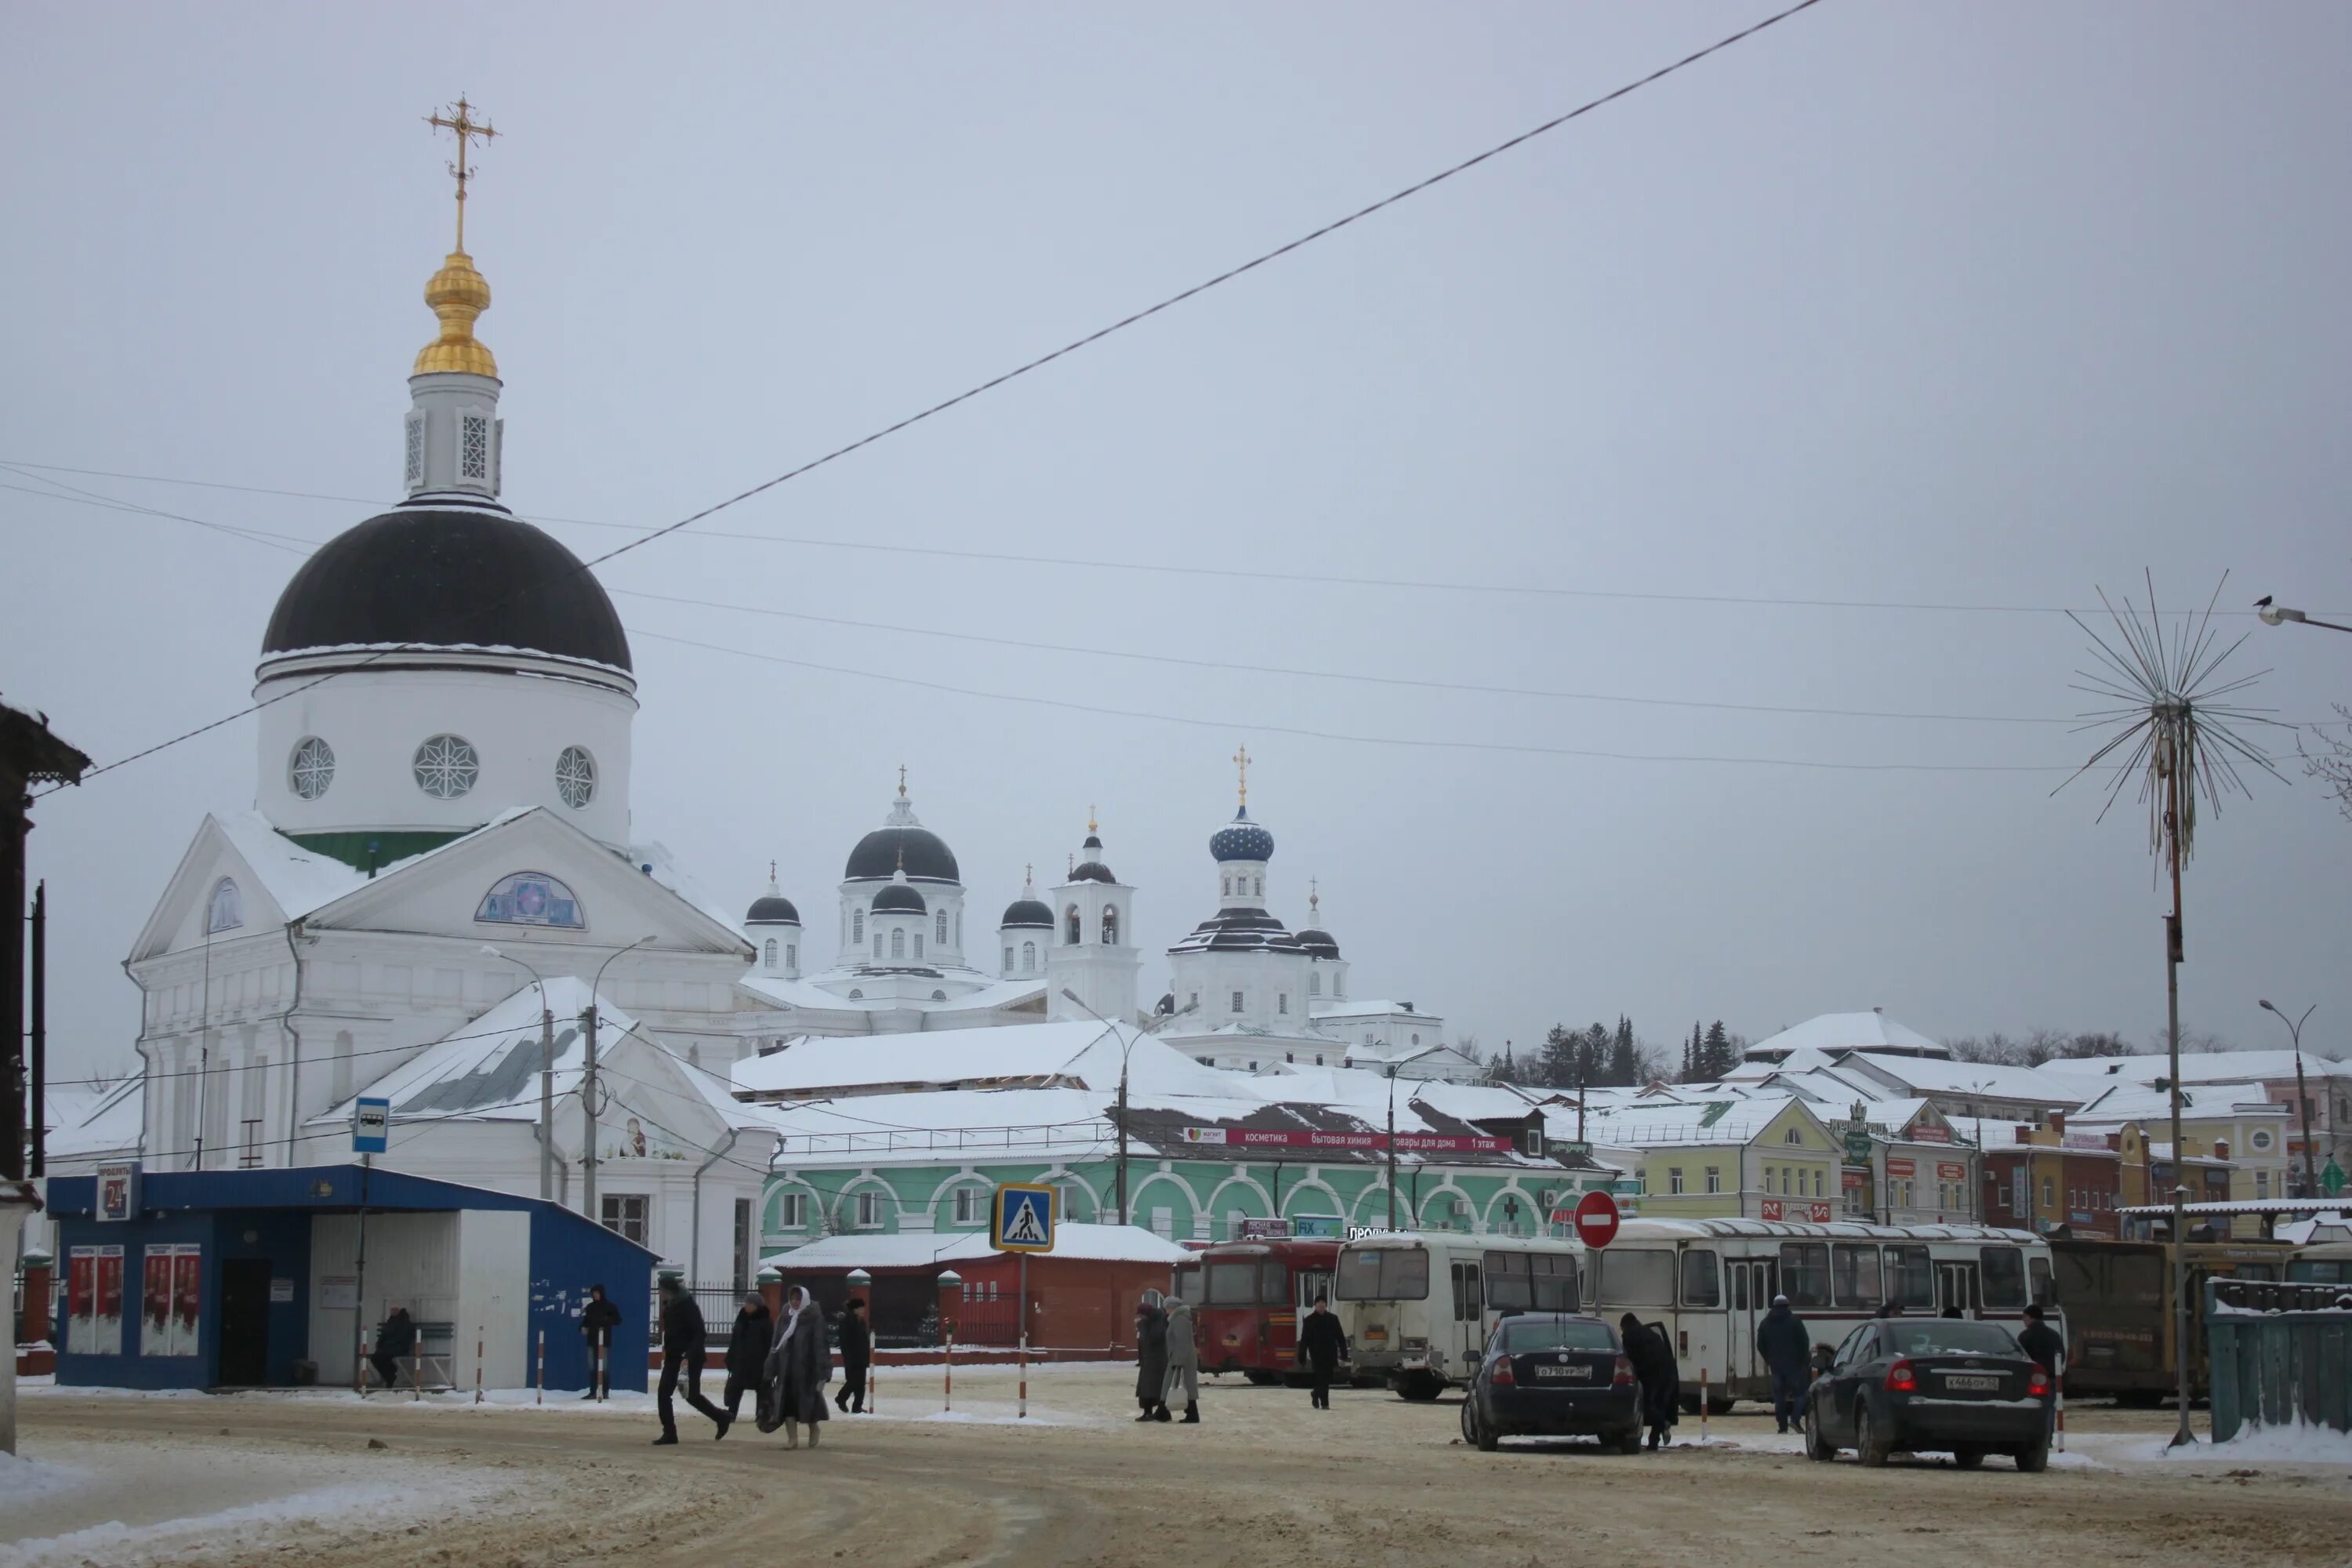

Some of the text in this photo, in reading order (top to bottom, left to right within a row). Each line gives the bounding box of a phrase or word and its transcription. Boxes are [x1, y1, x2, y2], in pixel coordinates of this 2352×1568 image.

[1830, 1119, 1865, 1132] МУЧНОЙ
[1245, 1132, 1495, 1149] косметика бытовая химия товары для дома 1 этаж
[100, 1167, 131, 1176] ПРОДУКТЫ
[107, 1185, 122, 1207] 24
[1298, 1221, 1314, 1235] FIX
